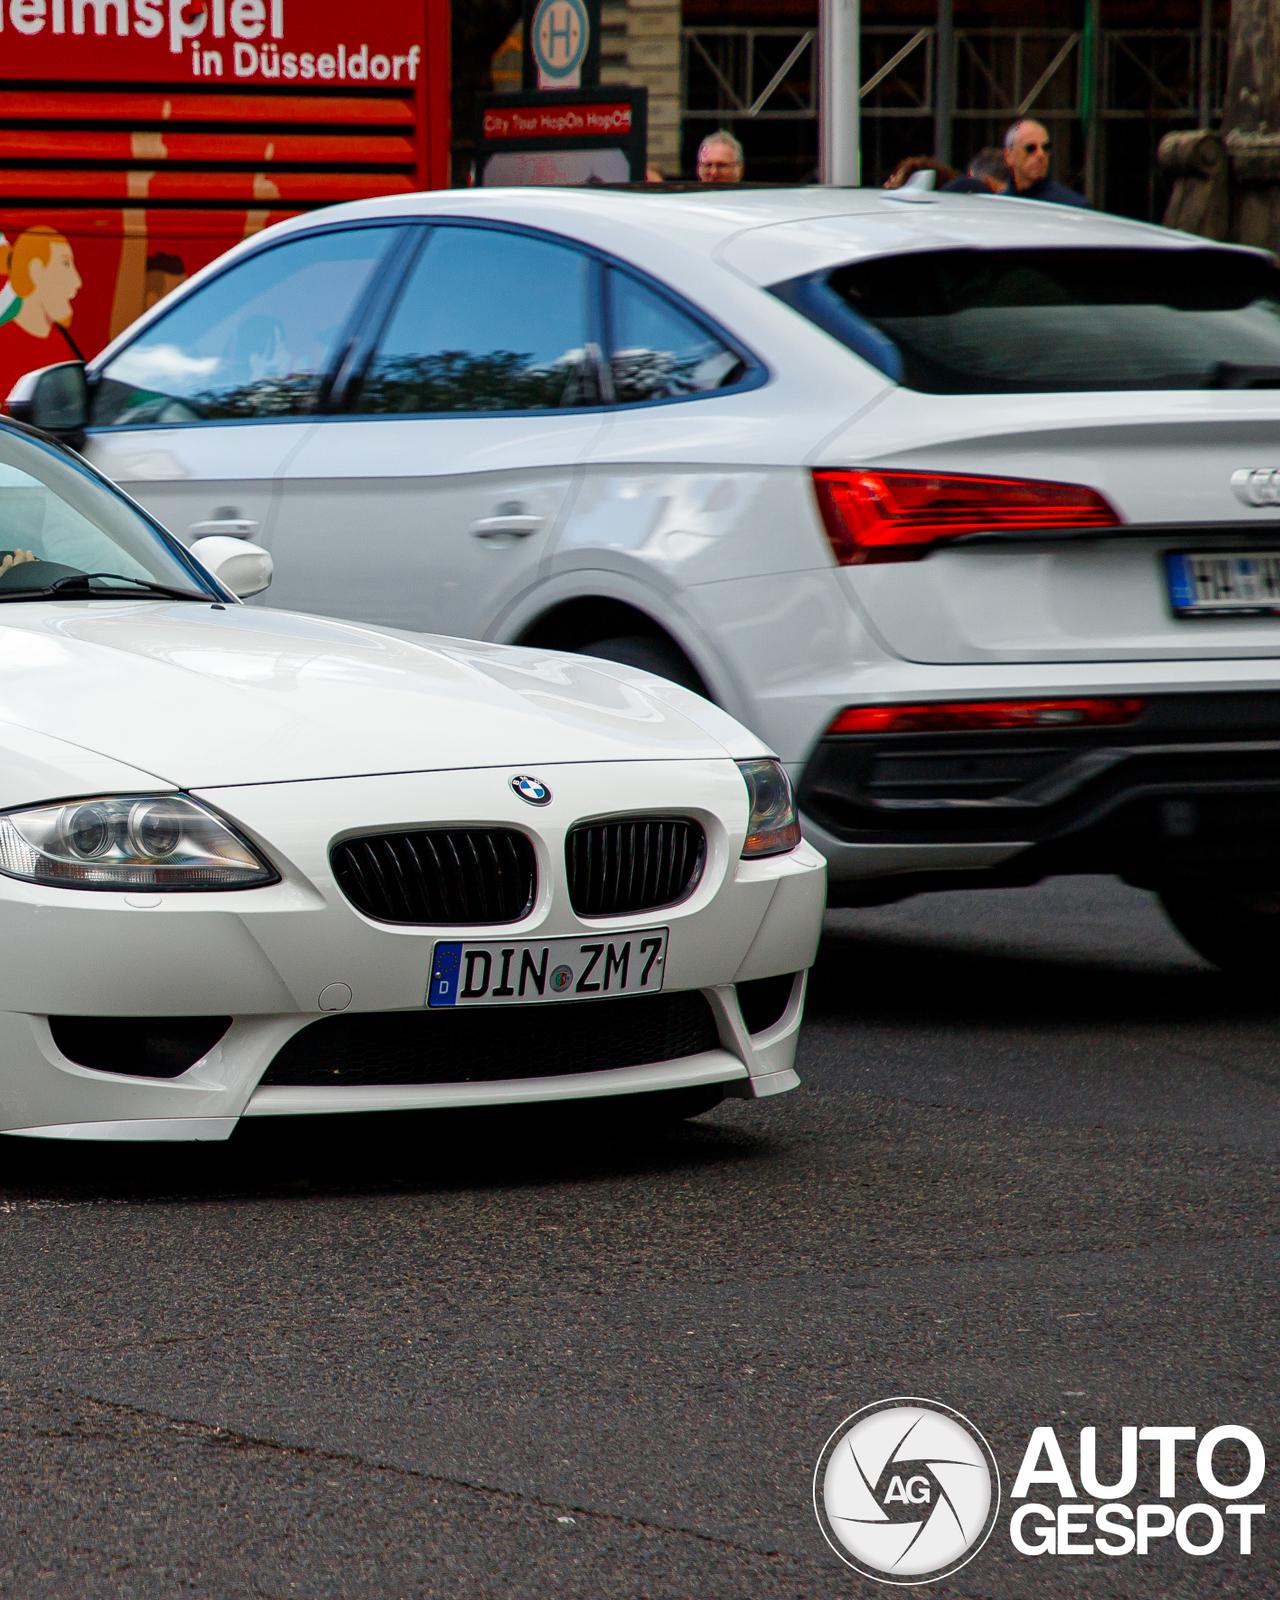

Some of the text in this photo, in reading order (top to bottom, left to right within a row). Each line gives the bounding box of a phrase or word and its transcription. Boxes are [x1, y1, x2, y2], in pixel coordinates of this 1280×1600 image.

[548, 9, 571, 60] H
[192, 41, 421, 81] in Düsseldorf
[484, 115, 509, 136] City
[438, 936, 663, 998] D DIN ZM 7
